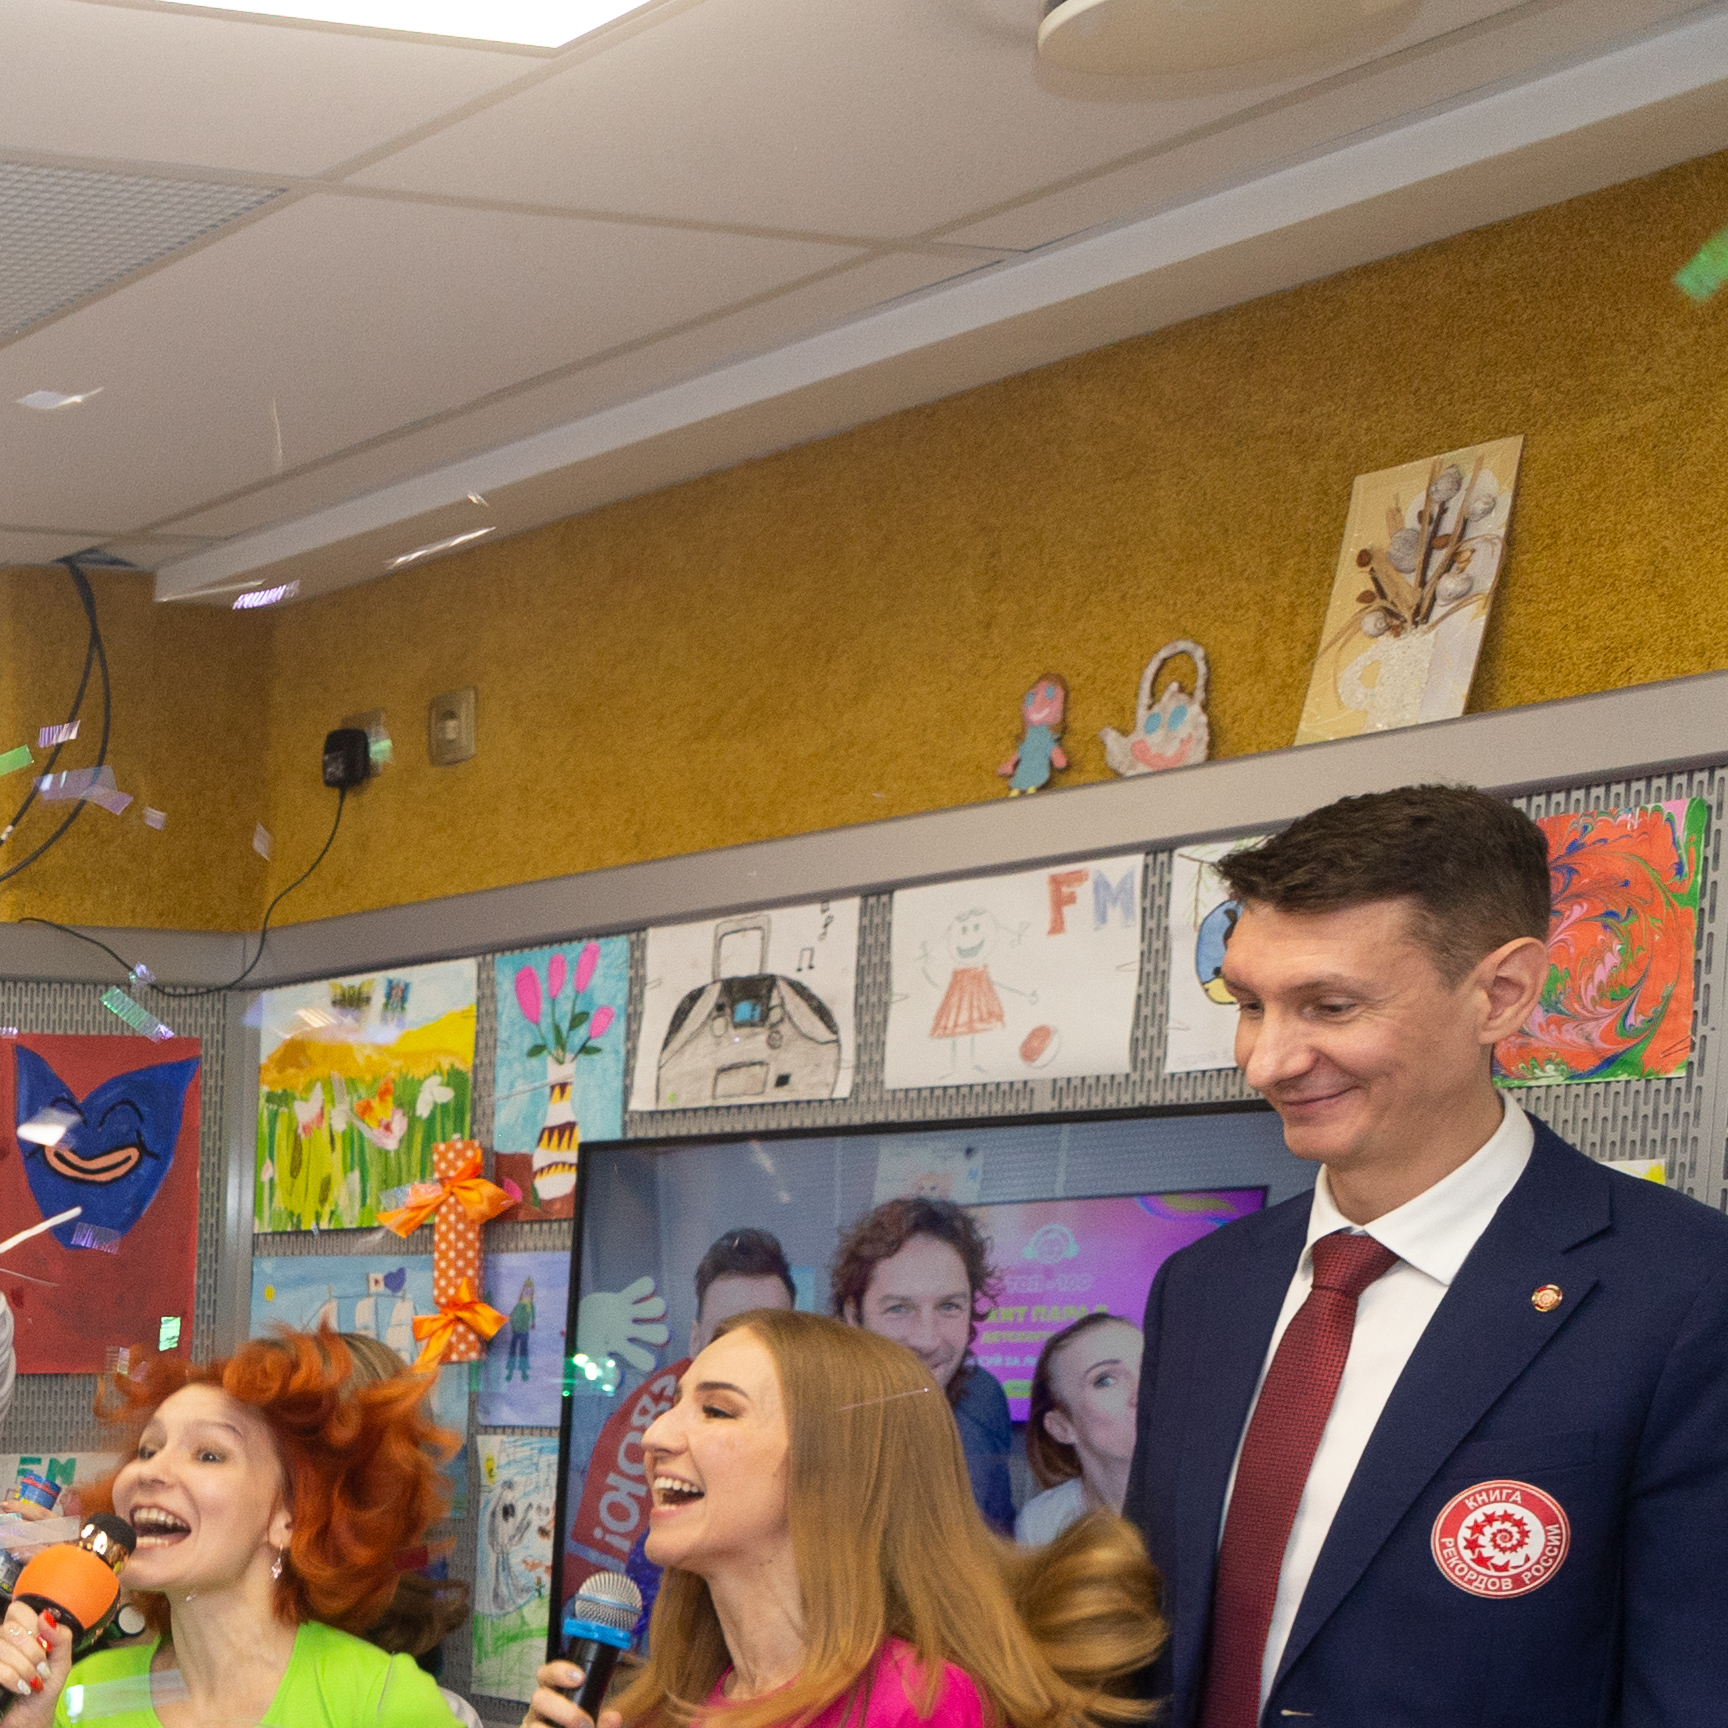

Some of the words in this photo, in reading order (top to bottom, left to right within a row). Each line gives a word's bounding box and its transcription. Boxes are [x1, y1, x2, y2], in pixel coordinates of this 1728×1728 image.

[1047, 867, 1138, 937] FM
[1464, 1489, 1523, 1511] КНИГА
[1441, 1537, 1514, 1591] РЕКОРДОВ
[1523, 1523, 1562, 1584] РОССИИ
